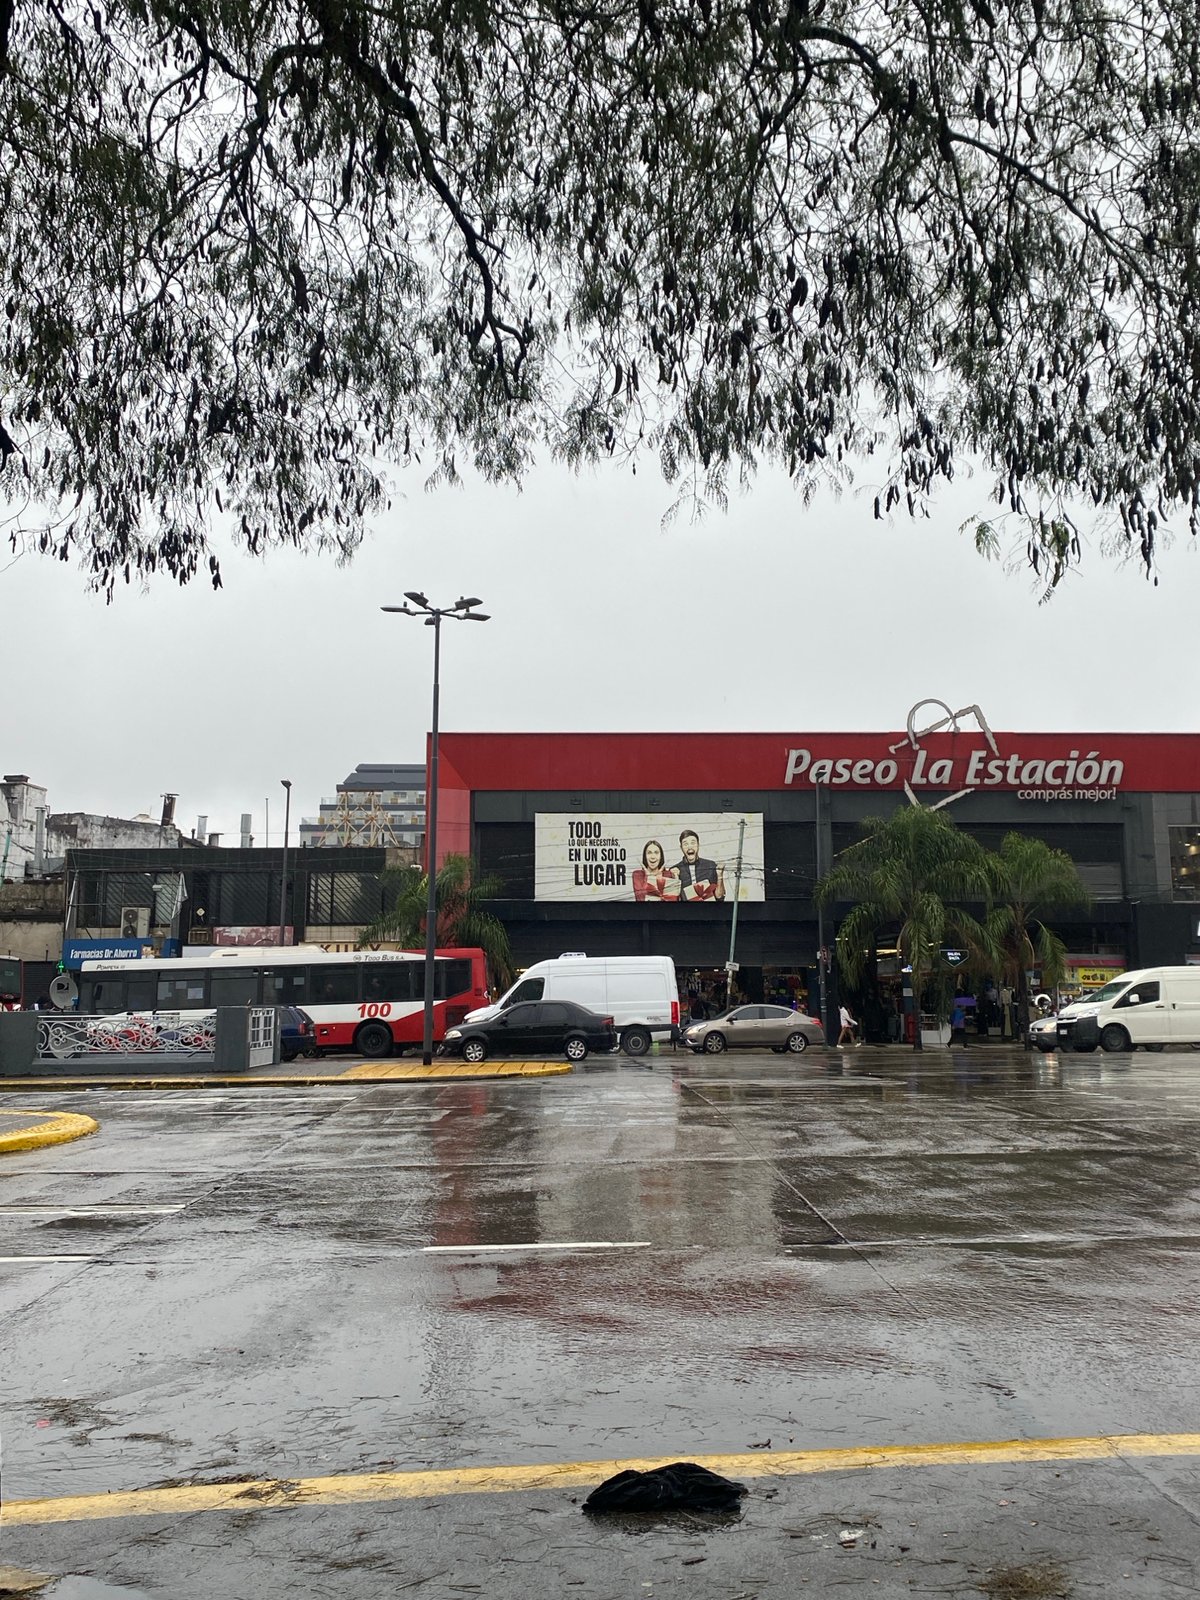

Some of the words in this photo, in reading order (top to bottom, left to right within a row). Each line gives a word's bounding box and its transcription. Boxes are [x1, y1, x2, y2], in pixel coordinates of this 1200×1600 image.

[784, 748, 898, 785] Paseo
[911, 749, 954, 785] La
[965, 750, 1124, 785] Estación
[1017, 786, 1073, 802] comprás
[1075, 786, 1117, 802] mejor!
[568, 821, 601, 838] TODO
[568, 838, 576, 847] LO
[577, 838, 588, 847] QUE
[589, 837, 620, 847] NECESITÁS,
[568, 848, 581, 862] EN
[584, 848, 598, 862] UN
[601, 848, 626, 861] SOLO
[574, 864, 626, 885] LUGAR
[70, 949, 104, 959] Farmacias
[113, 948, 138, 958] Ahorro
[357, 1003, 392, 1019] 100
